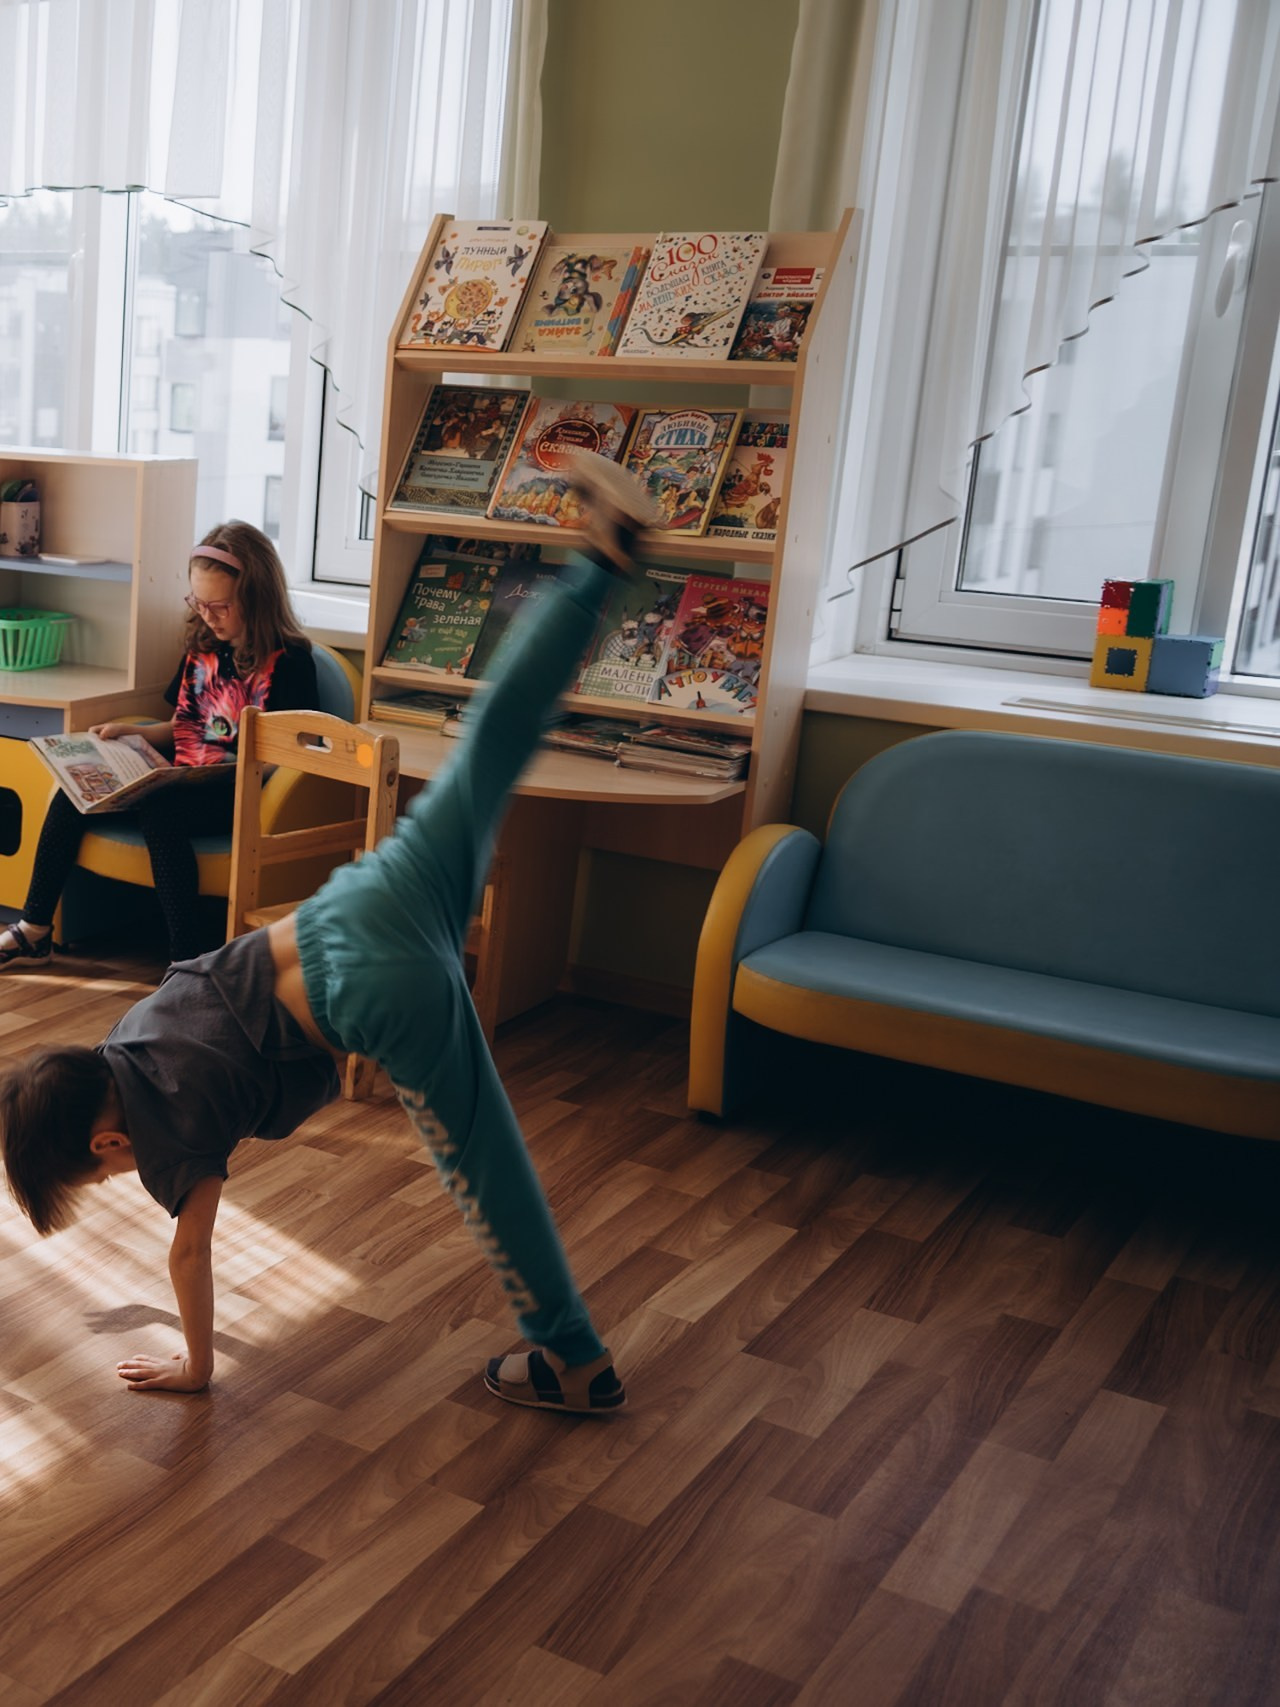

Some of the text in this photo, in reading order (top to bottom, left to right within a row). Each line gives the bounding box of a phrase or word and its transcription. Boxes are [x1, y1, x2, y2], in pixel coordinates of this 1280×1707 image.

[461, 246, 507, 256] ЛУННЫЙ
[666, 234, 718, 266] 100
[701, 260, 727, 276] КНИГА
[654, 429, 708, 446] СТИХИ
[412, 582, 462, 603] Почему
[692, 580, 770, 599] СЕРГЕЙ МИХАЛ
[414, 596, 446, 612] трава
[433, 611, 482, 626] зелёная
[600, 667, 654, 683] МАЛЕНЬ
[657, 678, 672, 700] А
[668, 670, 707, 688] ЧТО
[711, 671, 726, 683] У
